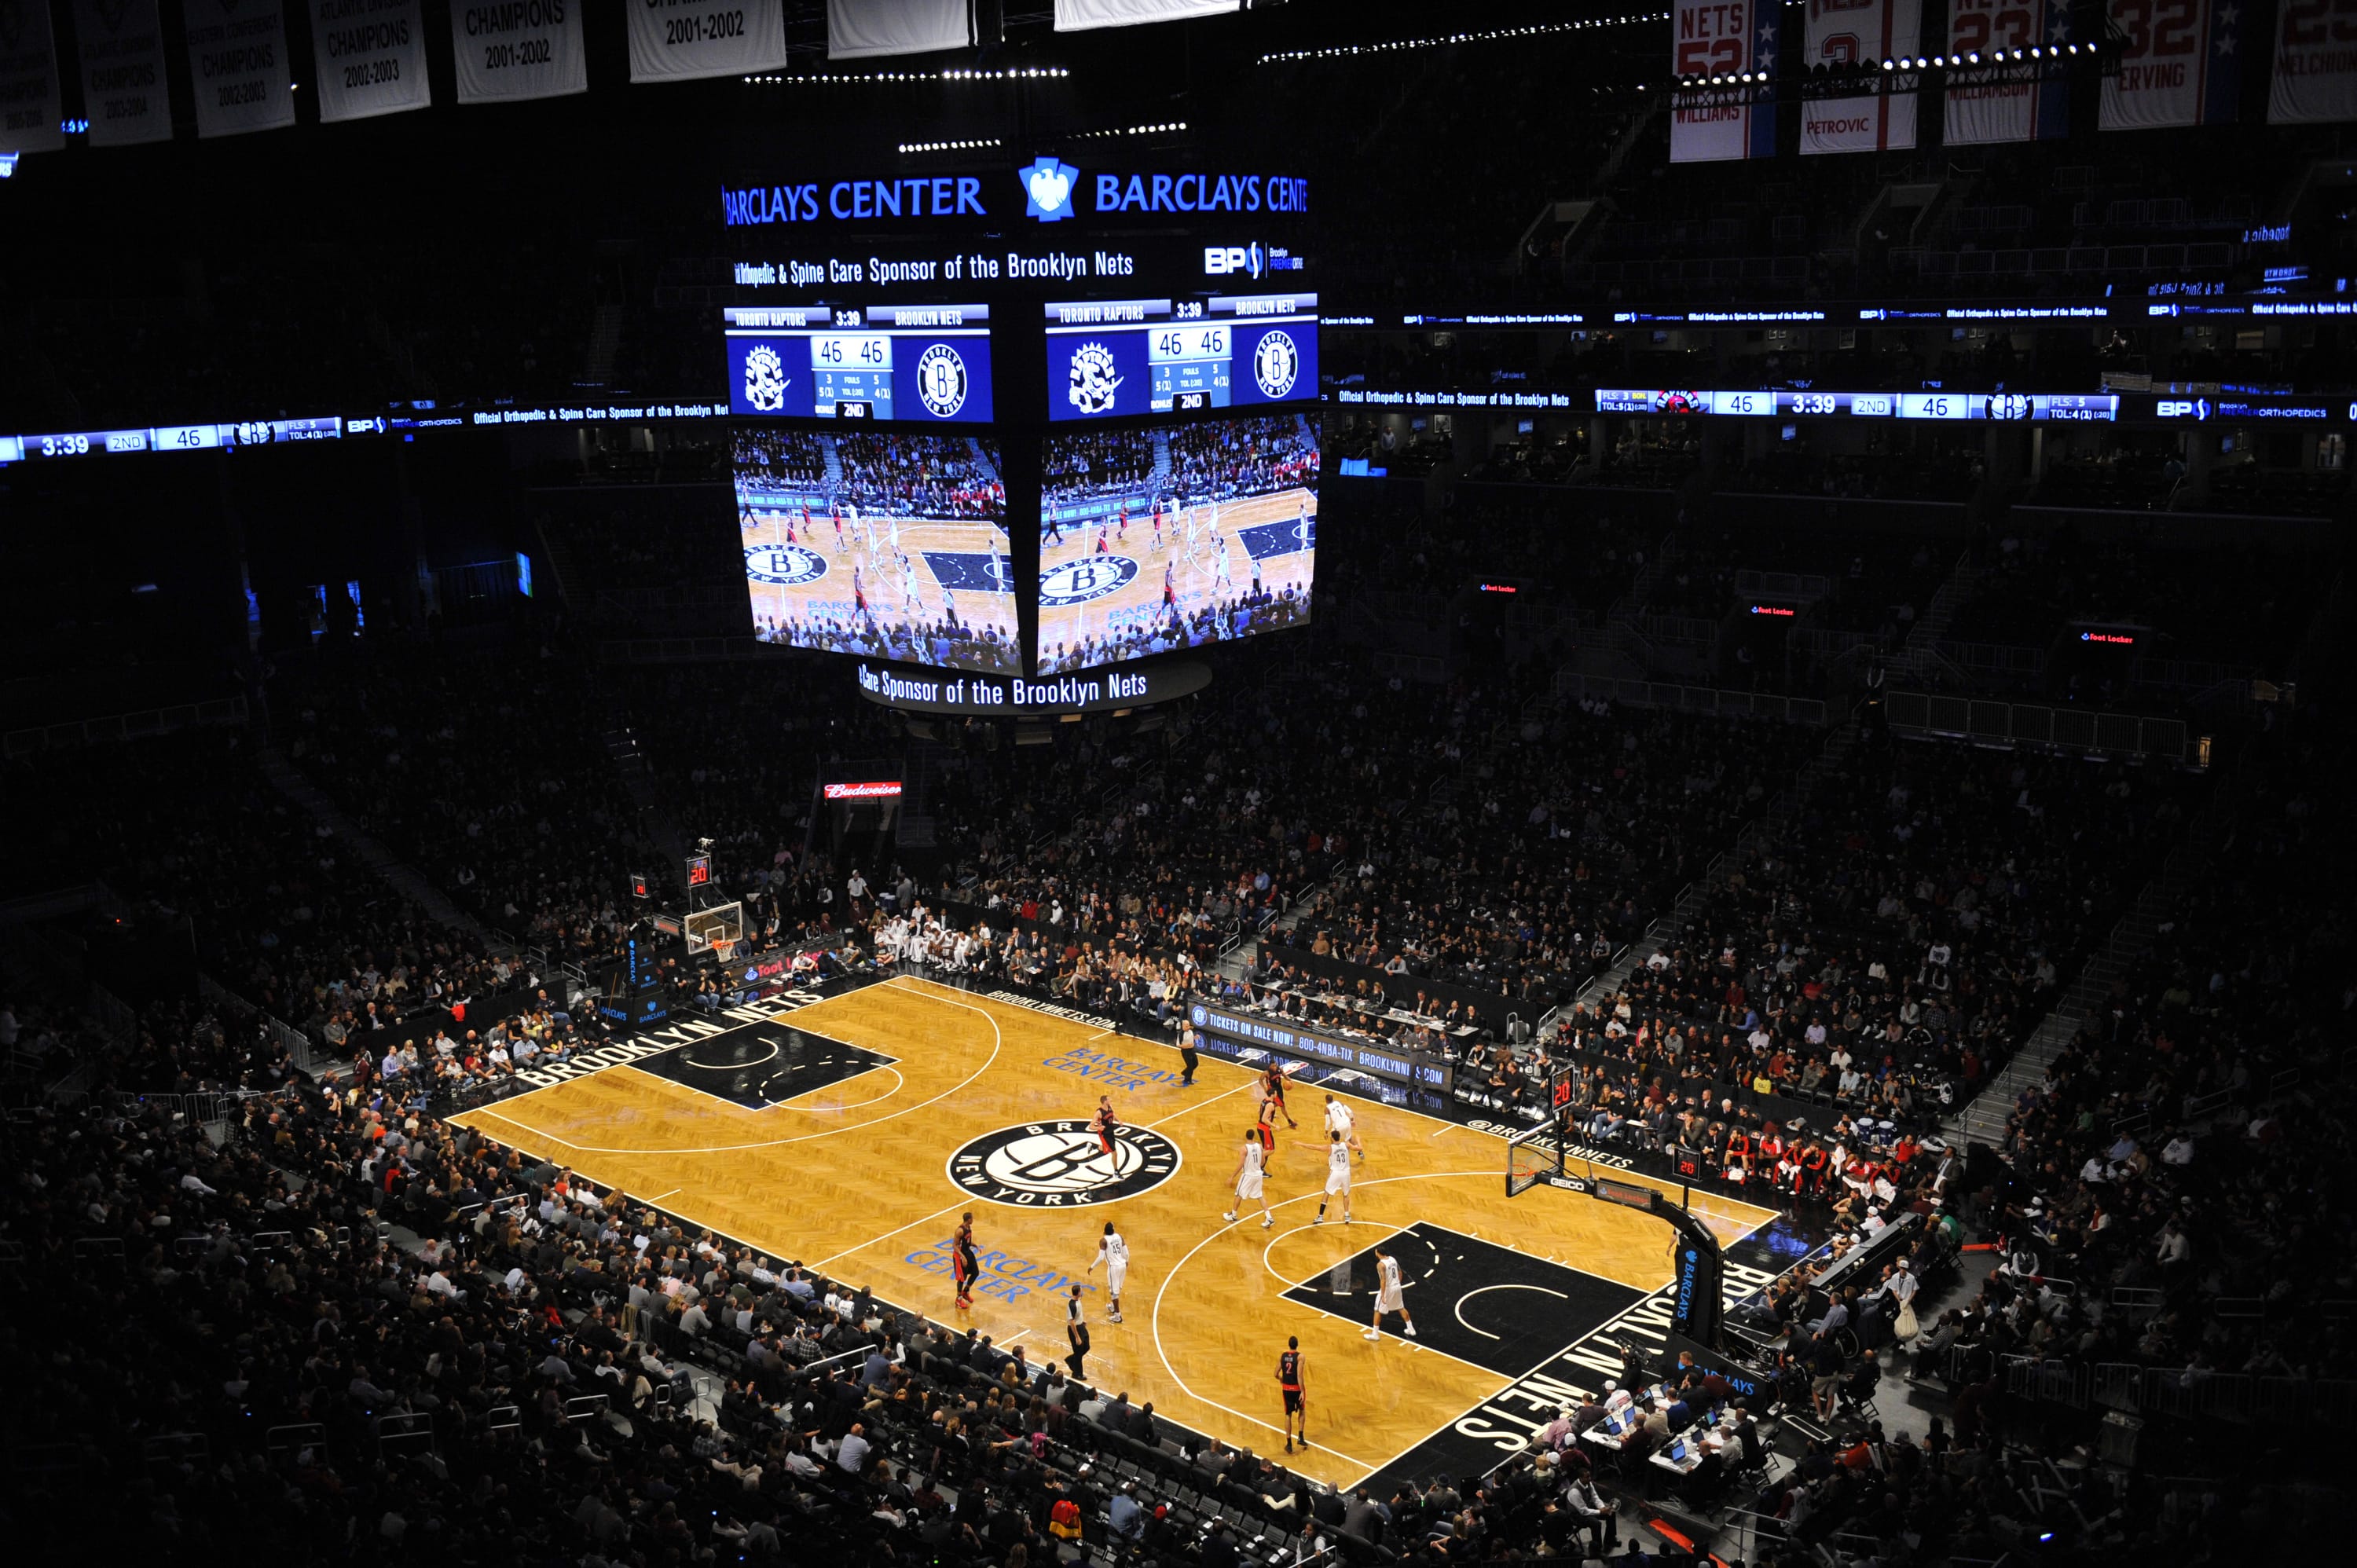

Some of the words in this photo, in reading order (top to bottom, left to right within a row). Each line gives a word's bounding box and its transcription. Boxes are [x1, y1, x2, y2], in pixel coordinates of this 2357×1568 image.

[466, 0, 564, 35] CHAMPIONS
[1681, 3, 1743, 39] NETS
[666, 10, 744, 45] 2001-2002
[328, 19, 409, 57] CHAMPIONS
[203, 44, 274, 77] CHAMPIONS
[486, 38, 551, 68] 2001-2002
[345, 59, 399, 88] 2002-2003
[2119, 63, 2184, 91] ERVING
[1949, 82, 2029, 101] WILLIAMSON
[1676, 105, 1739, 123] WILLIAMS
[1807, 118, 1869, 135] PETROVIC
[726, 184, 819, 225] BARCLAYS
[830, 178, 987, 218] CENTER
[1096, 174, 1260, 213] BARCLAYS
[740, 262, 775, 288] Orthopedic
[779, 264, 787, 284] &
[790, 260, 824, 288] Spine
[830, 258, 862, 283] Care
[870, 258, 937, 286] Sponsor
[945, 255, 962, 280] of
[970, 255, 999, 279] the
[1009, 252, 1087, 281] Brooklyn
[1095, 251, 1133, 276] Nets
[1059, 306, 1101, 323] TORONTO
[1104, 306, 1144, 321] RAPTORS
[1177, 302, 1202, 318] 3:39
[1236, 300, 1274, 315] BROOKLYN
[1277, 299, 1296, 313] NETS
[2253, 303, 2274, 314] Official
[735, 312, 769, 327] TORONTO
[771, 312, 806, 327] RAPTORS
[836, 310, 860, 326] 3:39
[895, 311, 939, 326] BROOKLYN
[940, 310, 962, 325] NETS
[1160, 333, 1182, 356] 46
[1201, 331, 1222, 353] 46
[1258, 334, 1295, 358] BROOKLYN
[821, 341, 841, 363] 46
[861, 341, 882, 362] 46
[1164, 367, 1170, 377] 3
[1213, 364, 1218, 374] 5
[1272, 350, 1280, 379] B
[827, 375, 832, 384] 3
[874, 375, 879, 384] 5
[938, 365, 948, 398] B
[1259, 376, 1276, 395] NEW
[1277, 375, 1295, 394] YORK
[1151, 398, 1172, 409] BONUS
[1182, 394, 1202, 408] 2ND
[1340, 390, 1364, 402] Official
[1366, 390, 1404, 405] Orthopedic
[1406, 392, 1413, 403] &
[1415, 391, 1435, 406] Spine
[1438, 392, 1454, 404] Care
[1457, 392, 1486, 407] Sponsor
[1490, 393, 1498, 405] of
[1500, 393, 1513, 405] the
[1516, 393, 1549, 408] Brooklyn
[1552, 394, 1570, 406] Nets
[1731, 396, 1753, 412] 46
[1792, 394, 1836, 414] 3:39
[1858, 401, 1886, 413] 2ND
[1923, 398, 1948, 416] 46
[2051, 397, 2073, 407] FLS:
[2078, 397, 2086, 407] 5
[474, 412, 502, 424] Official
[504, 409, 547, 423] Orthopedic
[549, 409, 557, 420] &
[559, 408, 584, 421] Spine
[586, 407, 607, 419] Care
[609, 407, 643, 420] Sponsor
[647, 406, 655, 417] of
[658, 405, 672, 417] the
[675, 405, 712, 418] Brooklyn
[844, 404, 864, 418] 2ND
[310, 420, 317, 429] 5
[42, 435, 89, 456] 3:39
[112, 436, 141, 449] 2ND
[177, 430, 201, 447] 46
[2090, 633, 2106, 642] Foot
[2108, 635, 2132, 644] Locker
[863, 665, 879, 693] Care
[882, 671, 938, 702] Sponsor
[946, 679, 964, 704] of
[972, 680, 1003, 705] the
[1014, 677, 1099, 707] Brooklyn
[1109, 673, 1147, 698] Nets
[824, 784, 902, 798] Budweiser
[691, 866, 708, 883] 20
[758, 960, 784, 977] Foot
[721, 990, 825, 1023] NETS
[639, 1010, 668, 1023] BARCLAYS
[1209, 1013, 1239, 1033] TICKETS
[1241, 1024, 1252, 1035] ON
[1253, 1025, 1272, 1040] SALE
[1273, 1028, 1294, 1046] NOW!
[1299, 1036, 1354, 1061] 800-4NBA-TIX
[515, 1019, 727, 1088] BROOKLYN
[1043, 1057, 1146, 1092] CENTER
[1064, 1047, 1199, 1089] BARCLAYS
[1554, 1081, 1570, 1106] 20
[1337, 1109, 1343, 1118] 1
[1253, 1153, 1259, 1163] 11
[1336, 1153, 1346, 1163] 43
[955, 1155, 989, 1187] NEW
[1550, 1178, 1585, 1192] GEICO
[993, 1186, 1093, 1206] YORK
[1113, 1244, 1121, 1255] 45
[1391, 1267, 1396, 1279] 8
[1677, 1262, 1697, 1321] BARCLAYS
[1285, 1362, 1292, 1374] 2
